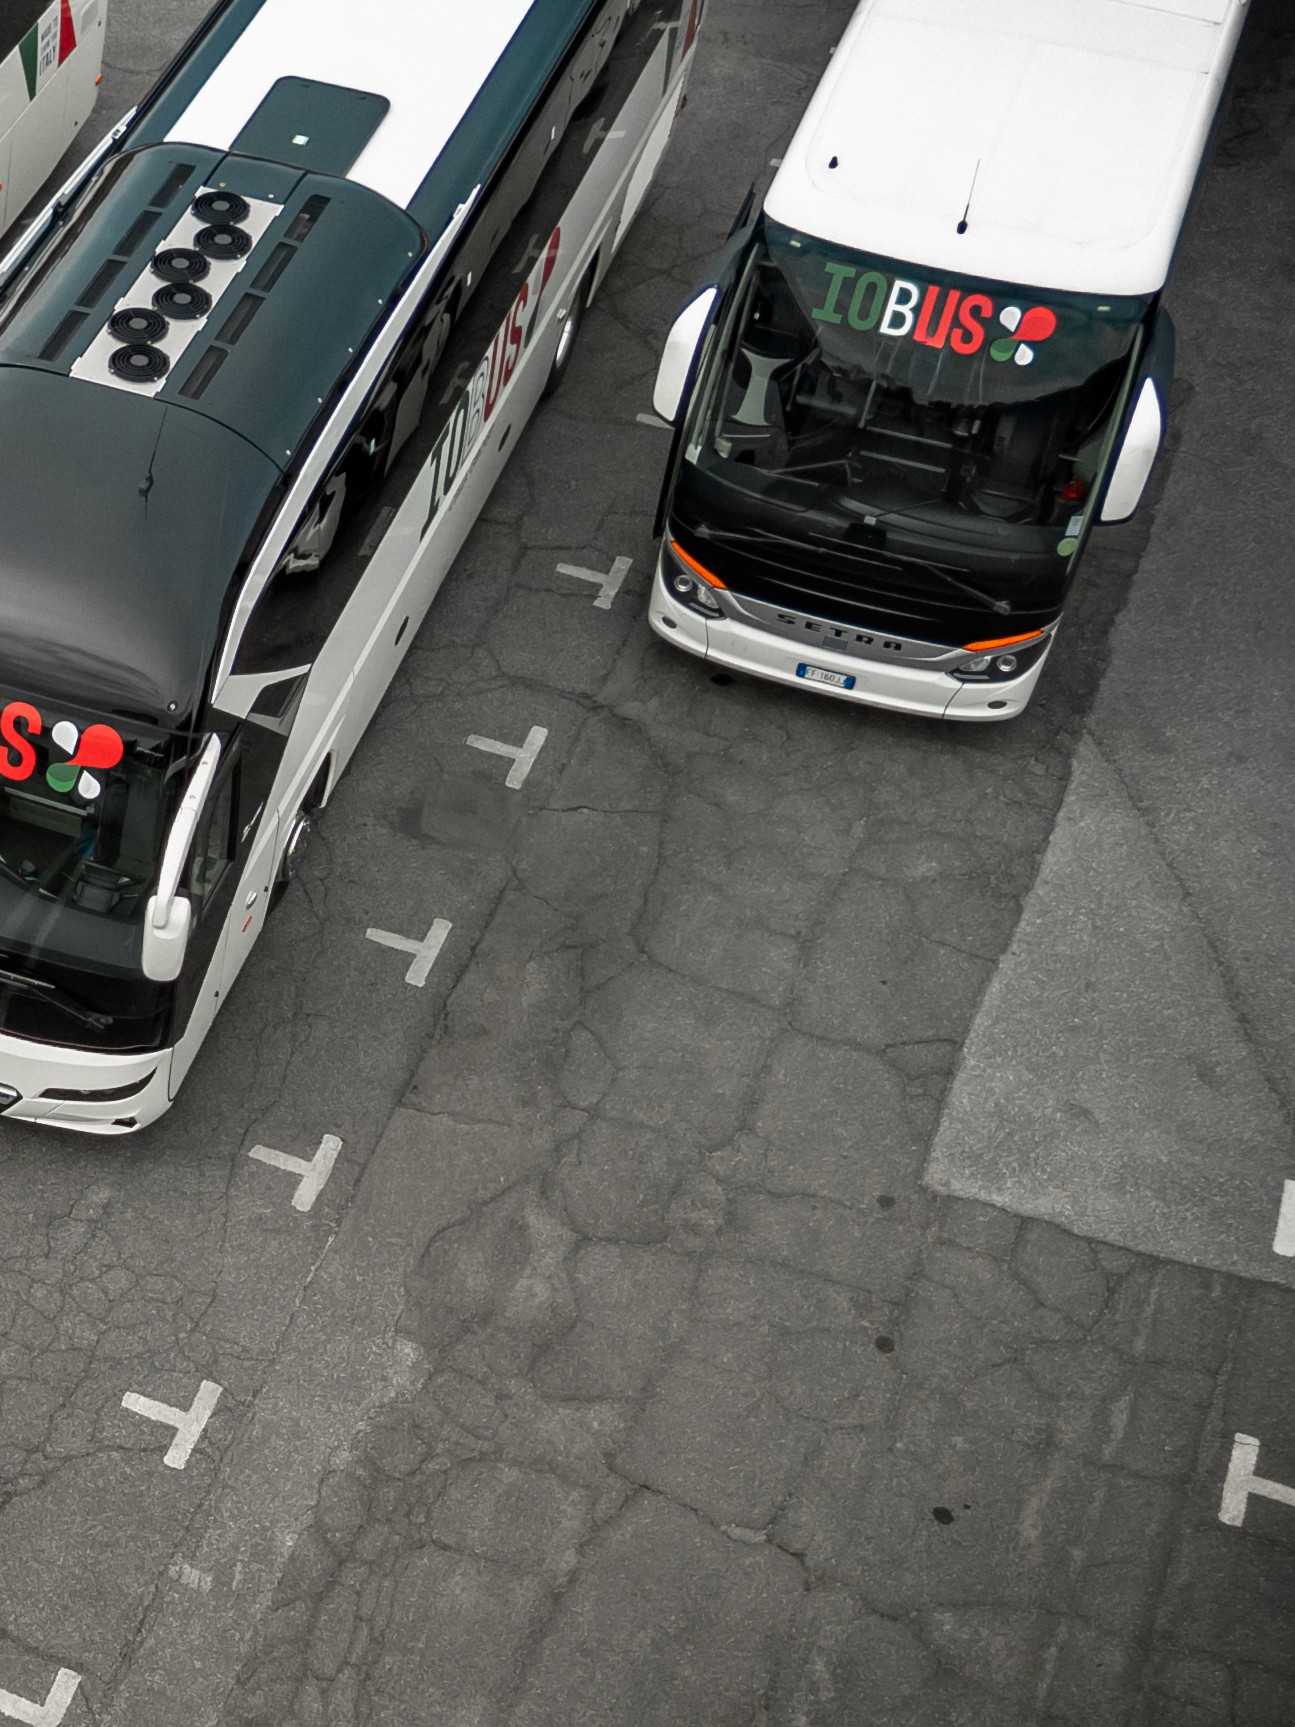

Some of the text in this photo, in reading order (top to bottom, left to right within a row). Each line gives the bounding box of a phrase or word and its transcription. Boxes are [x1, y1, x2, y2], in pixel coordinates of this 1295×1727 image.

[811, 261, 994, 355] IOBUS
[419, 281, 529, 544] IOBUS
[776, 613, 903, 651] SETRA
